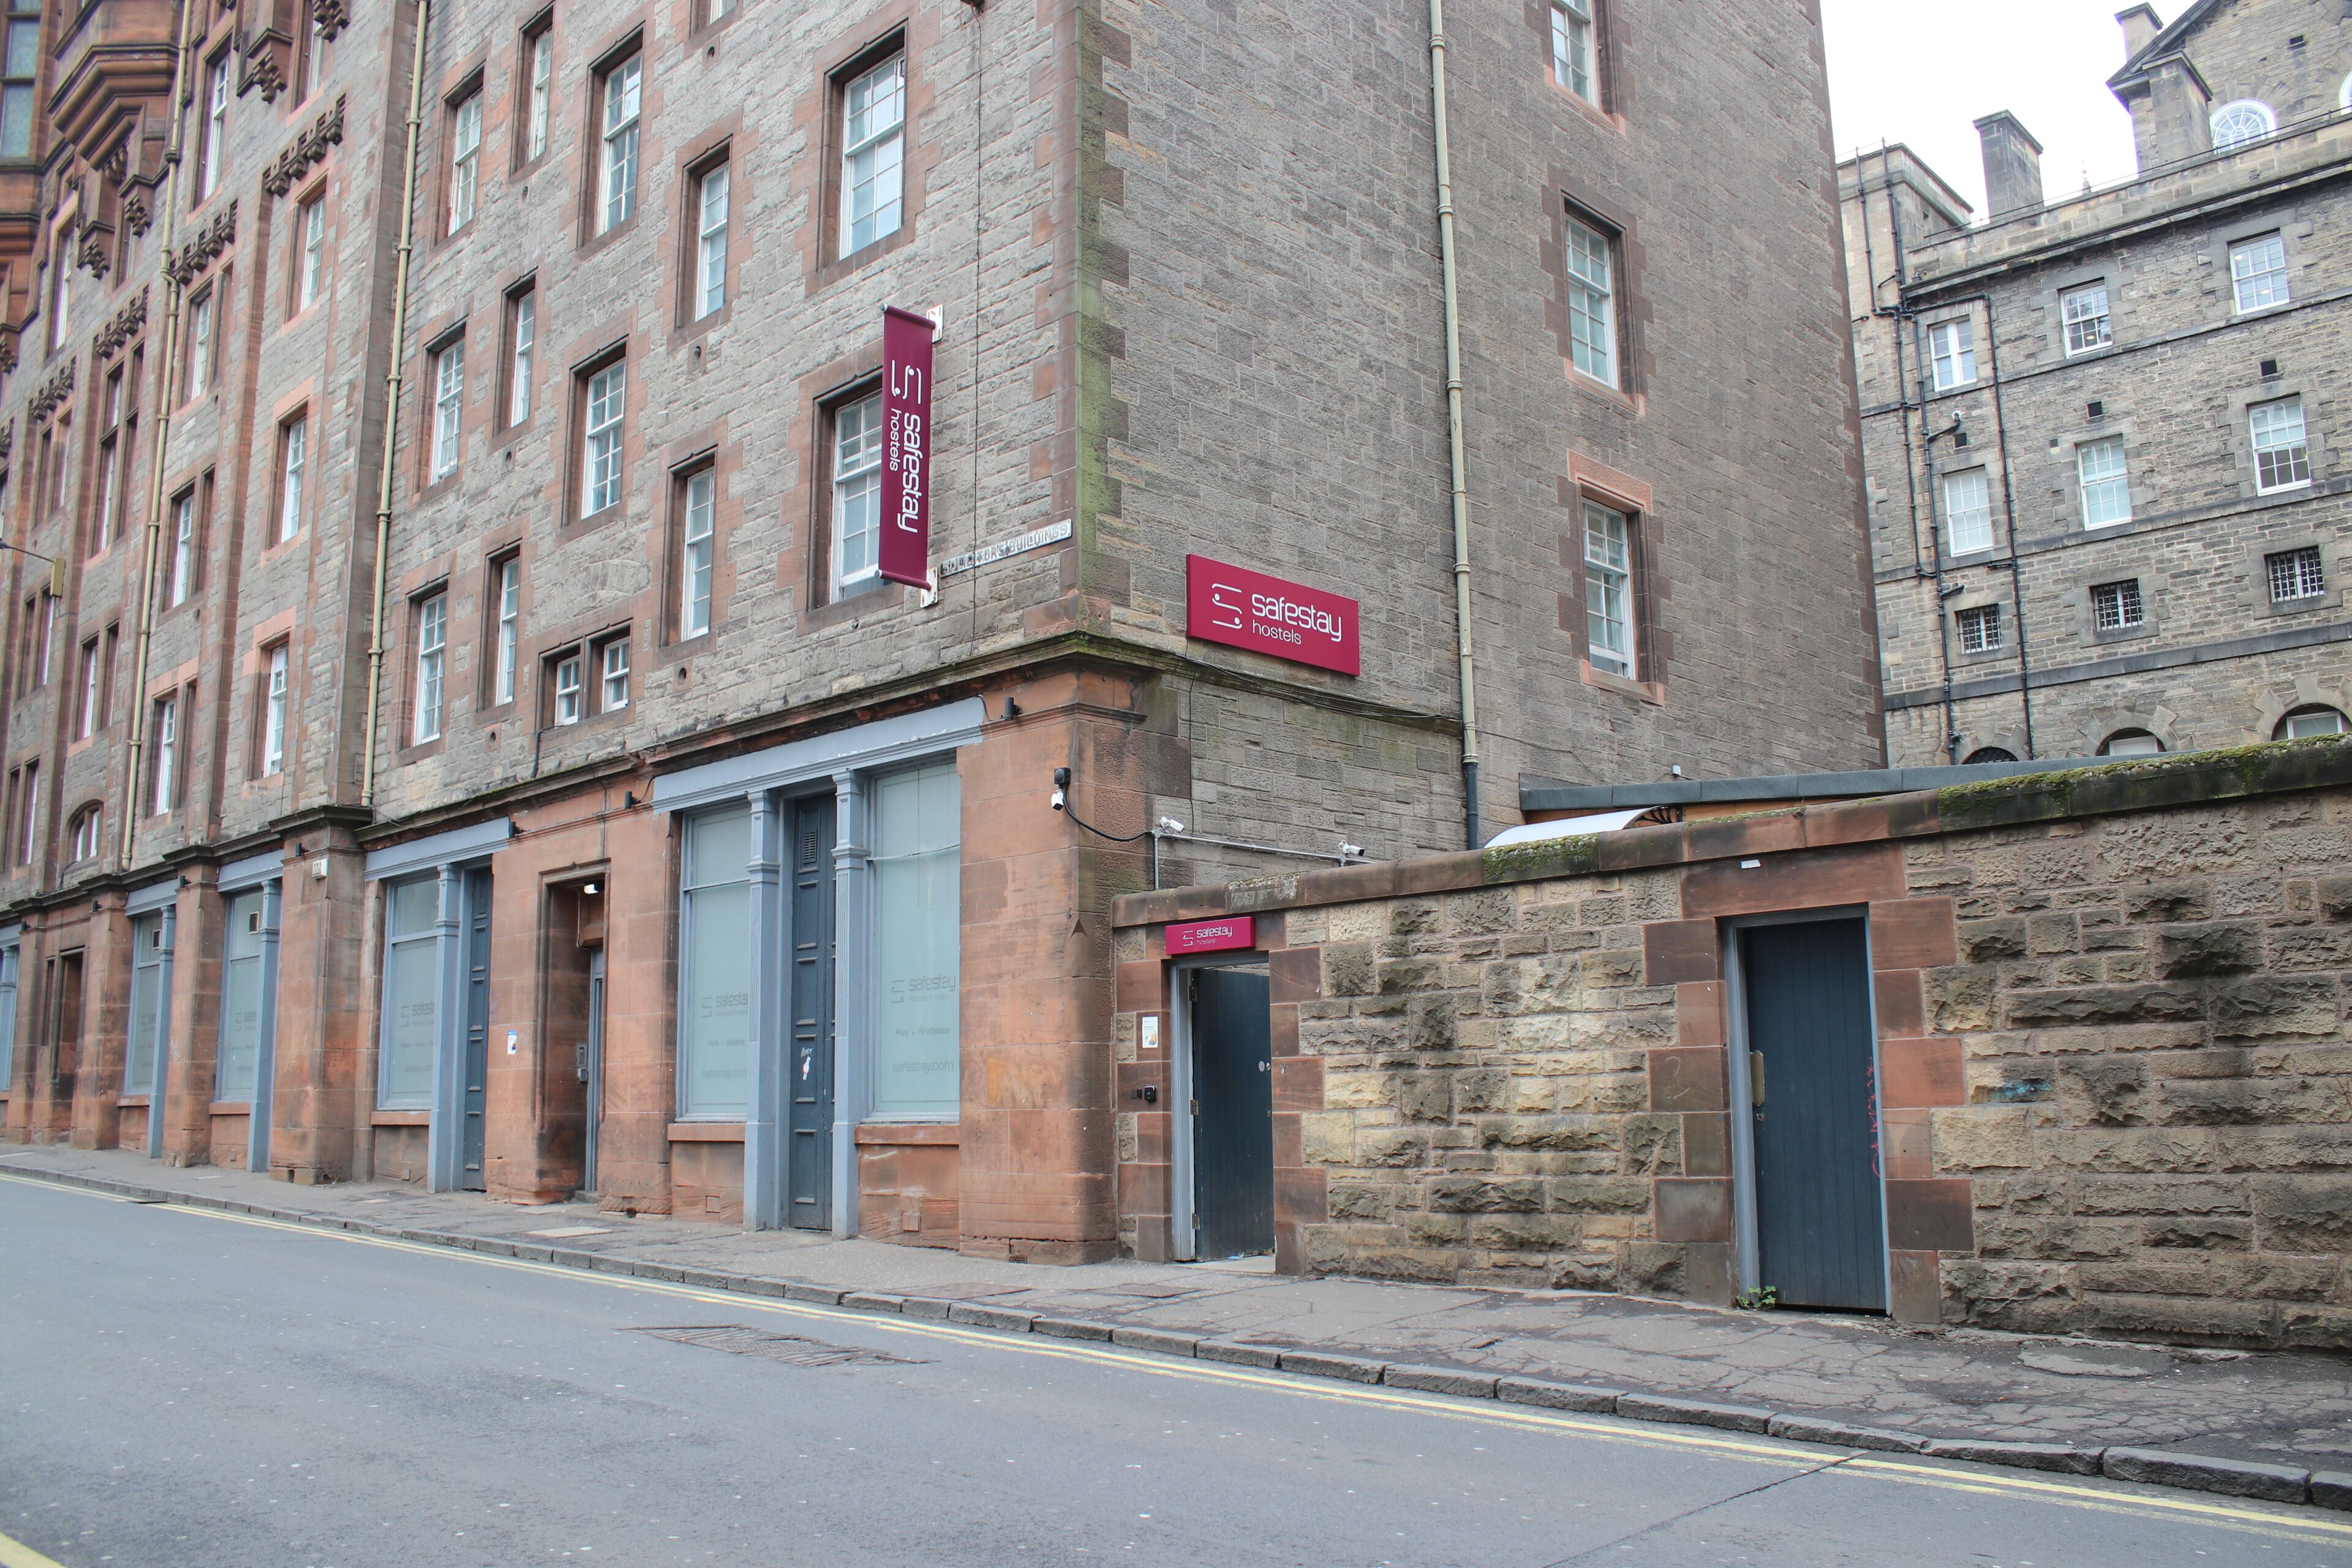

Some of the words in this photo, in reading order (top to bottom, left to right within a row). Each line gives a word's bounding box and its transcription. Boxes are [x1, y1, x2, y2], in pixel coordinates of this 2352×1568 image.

[889, 407, 902, 472] hostels
[897, 412, 923, 533] safestay
[1251, 593, 1342, 643] safestay
[1252, 619, 1302, 645] hostels
[1196, 925, 1232, 938] safestay
[909, 974, 956, 992] safestay
[892, 1060, 954, 1074] safestay.com
